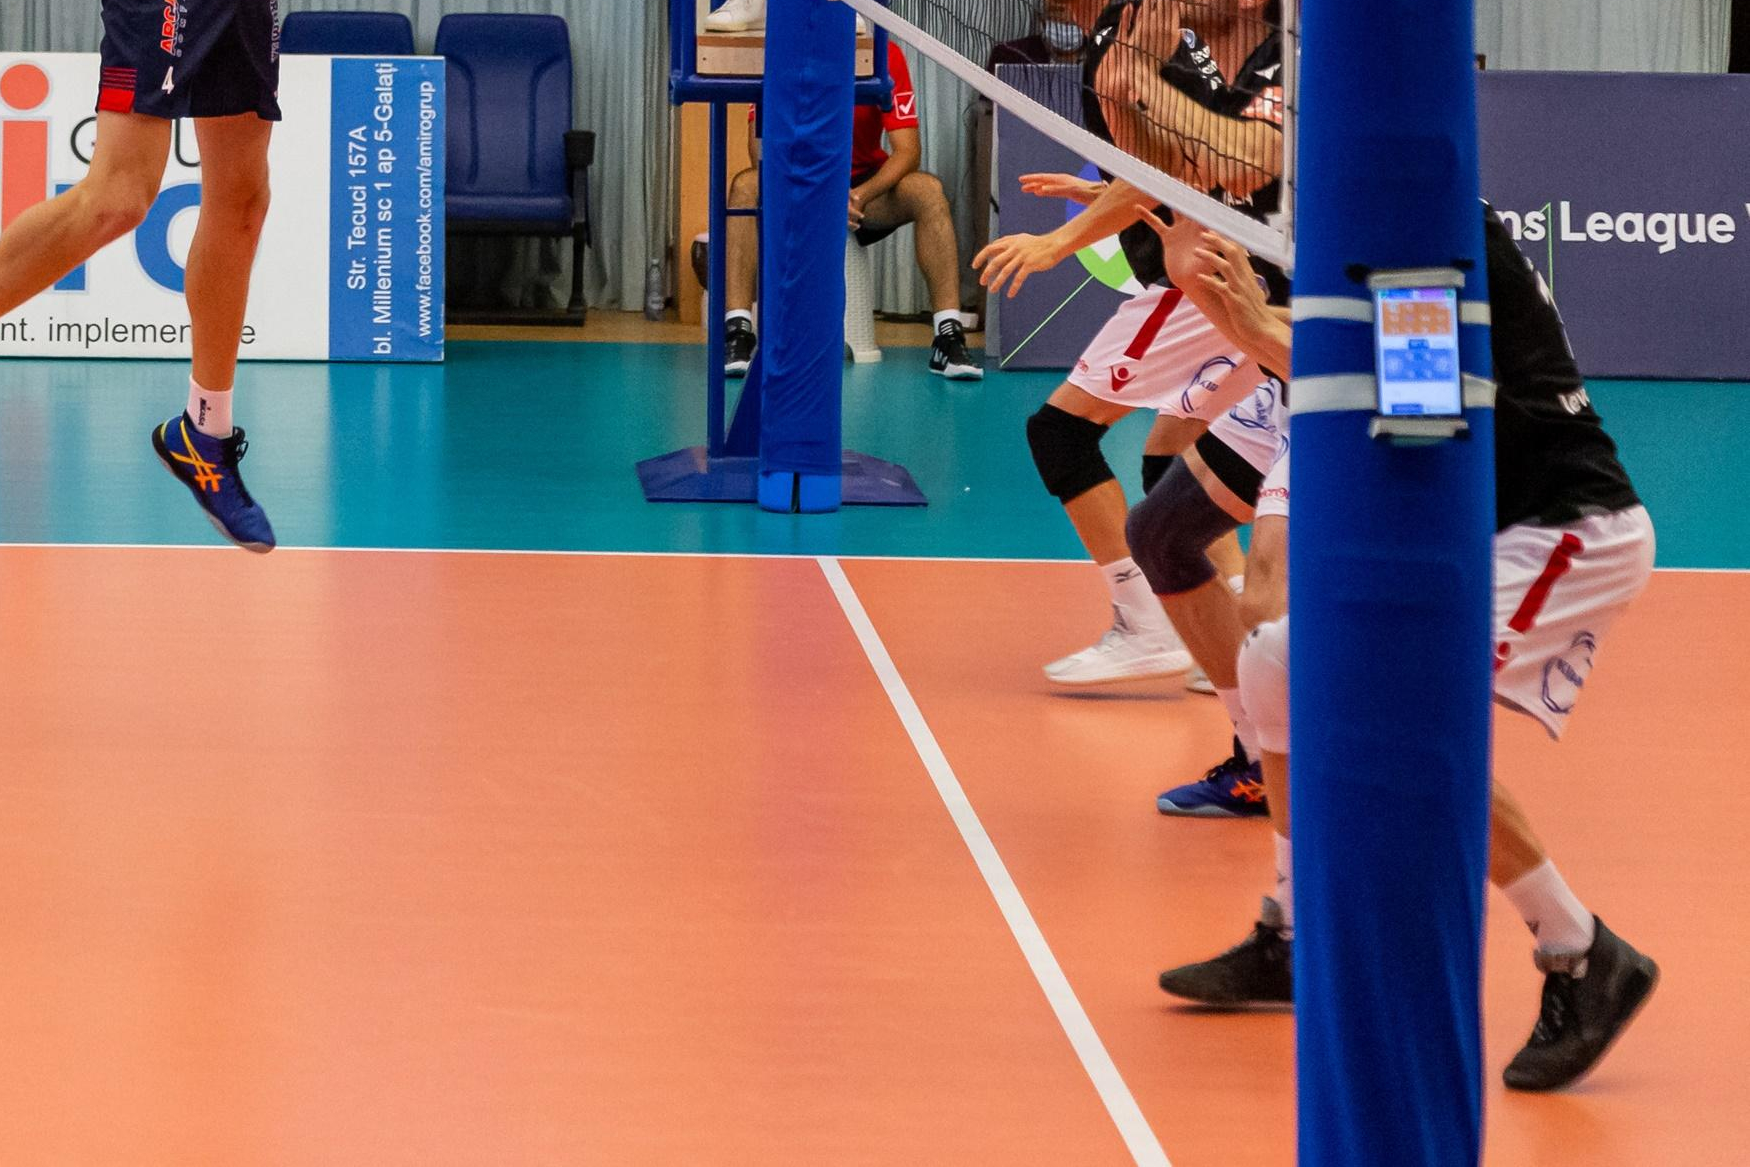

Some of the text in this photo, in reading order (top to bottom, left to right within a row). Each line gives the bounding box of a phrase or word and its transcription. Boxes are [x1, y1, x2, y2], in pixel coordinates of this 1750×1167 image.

[161, 65, 175, 96] 4
[377, 149, 397, 174] ap
[374, 182, 392, 190] 1
[348, 125, 367, 290] Str. Tecuci 157A
[377, 197, 393, 222] sc
[416, 80, 437, 337] www.facebook.com/amirogrup
[1559, 200, 1737, 255] League
[373, 227, 392, 324] Millenium
[373, 331, 392, 355] bl.
